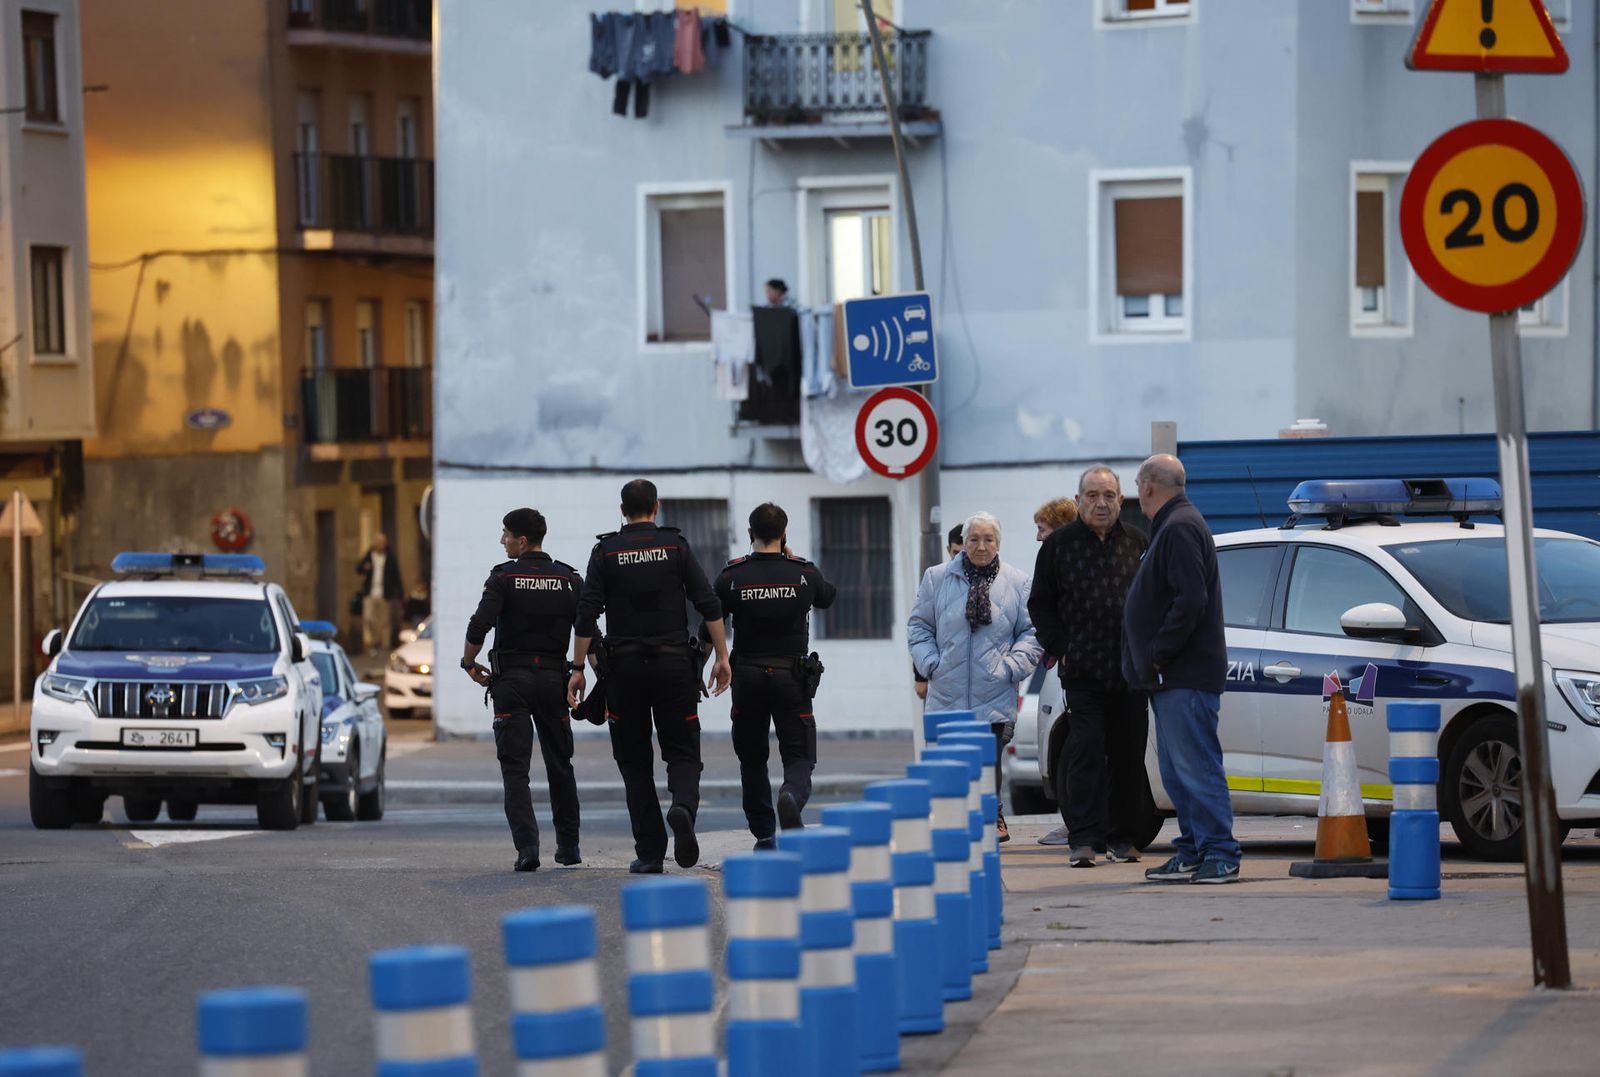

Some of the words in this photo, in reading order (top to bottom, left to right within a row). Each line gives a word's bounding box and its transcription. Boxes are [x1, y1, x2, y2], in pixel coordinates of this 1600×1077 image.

[1440, 182, 1540, 249] 20
[874, 418, 918, 447] 30
[618, 549, 668, 565] ERTZAINTZA
[515, 578, 562, 590] ERTZAINTZA
[741, 587, 797, 600] ERTZAINTZA
[1353, 707, 1374, 715] UDALA
[160, 732, 190, 744] 2641
